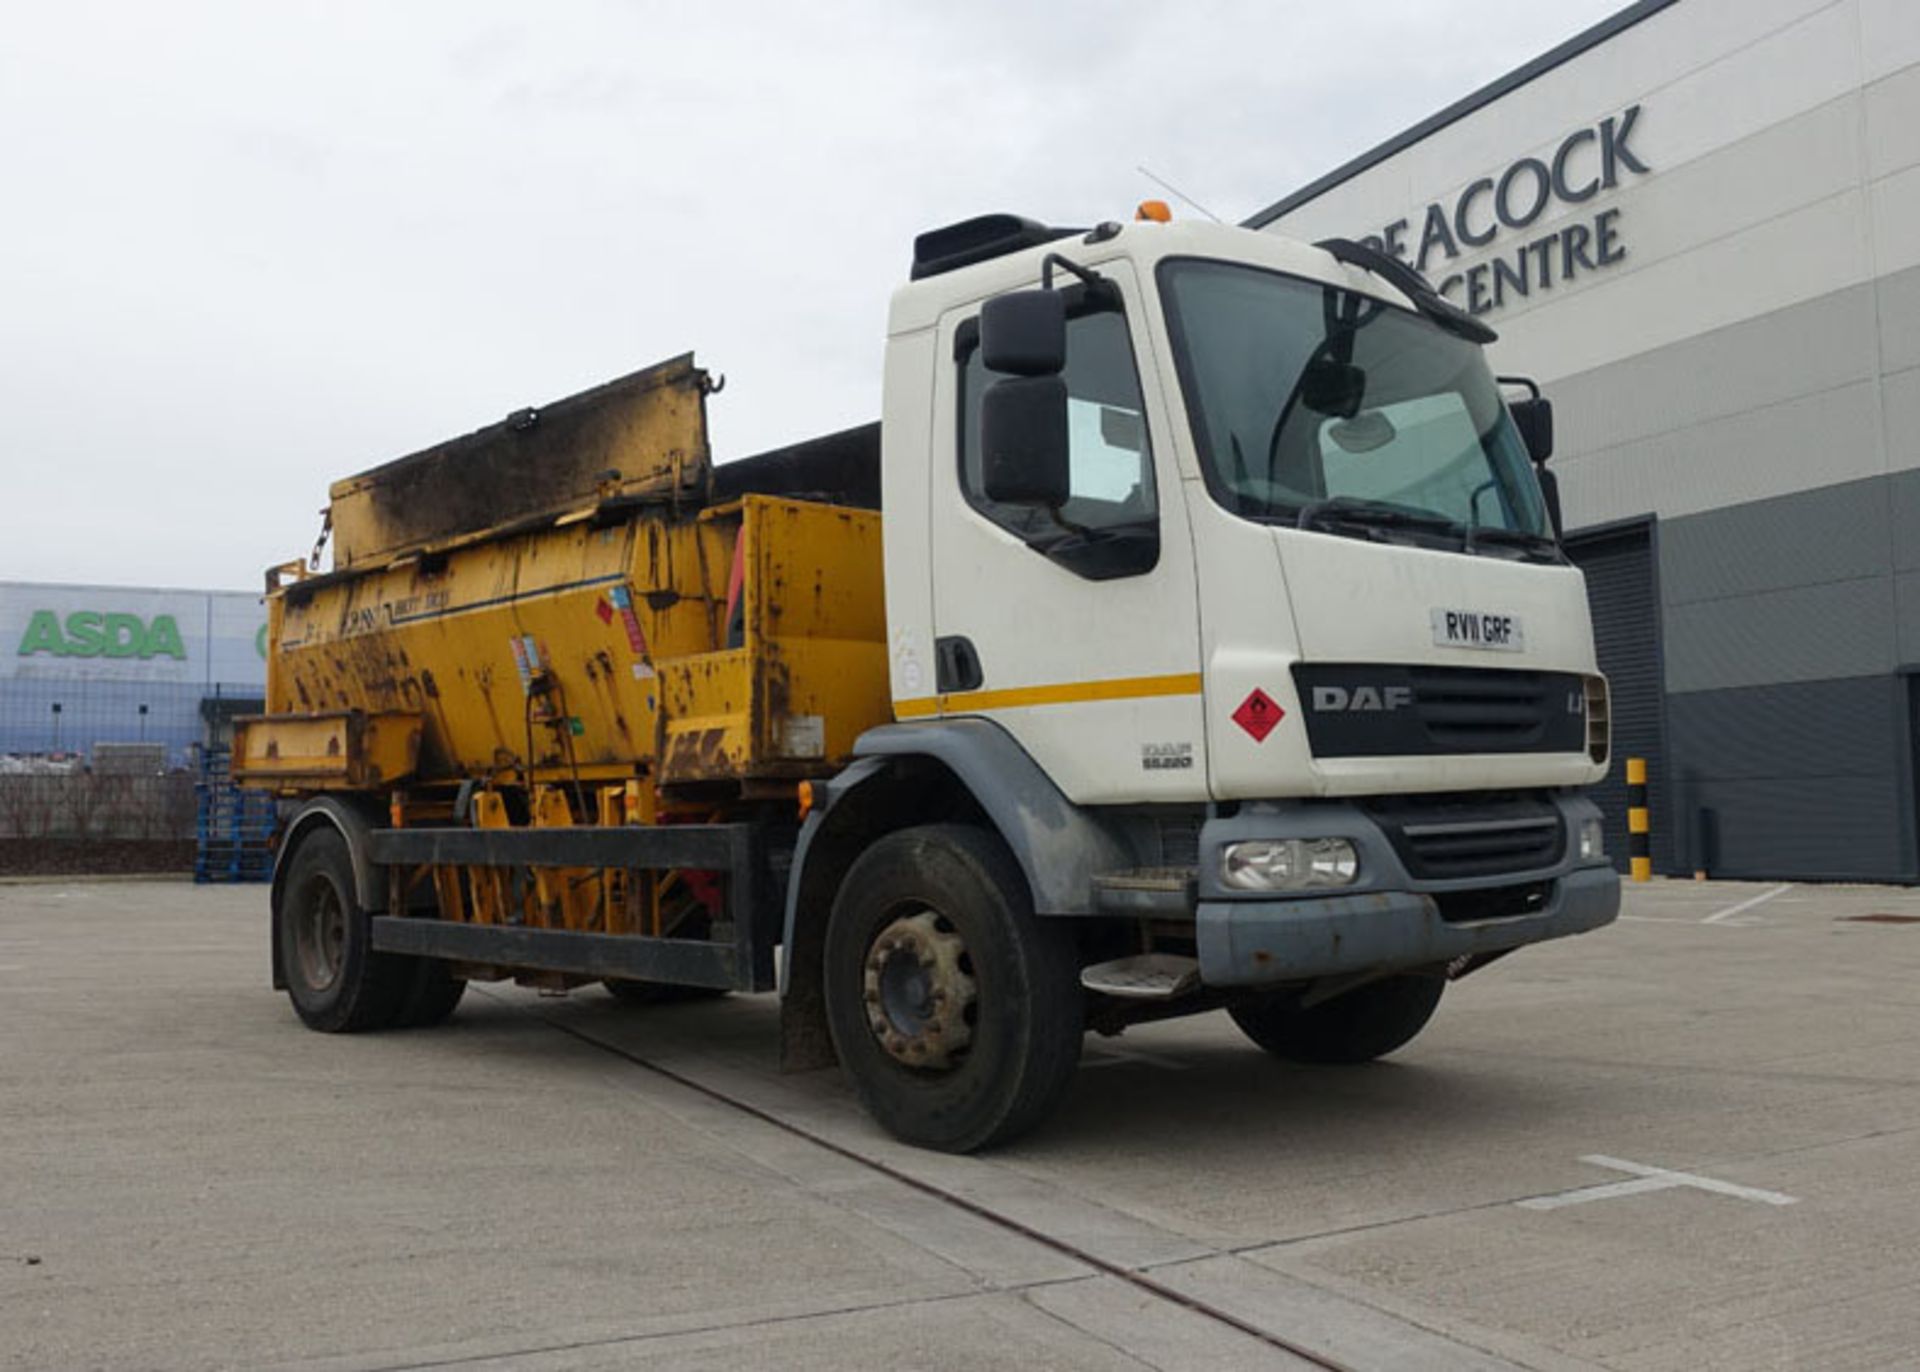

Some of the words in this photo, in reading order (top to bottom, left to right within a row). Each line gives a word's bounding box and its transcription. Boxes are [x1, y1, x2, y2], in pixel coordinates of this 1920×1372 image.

[1438, 208, 1625, 315] CENTRE
[17, 609, 187, 661] ASDA
[1446, 611, 1480, 642] RV11
[1483, 615, 1512, 644] GRF
[1312, 686, 1411, 711] DAF
